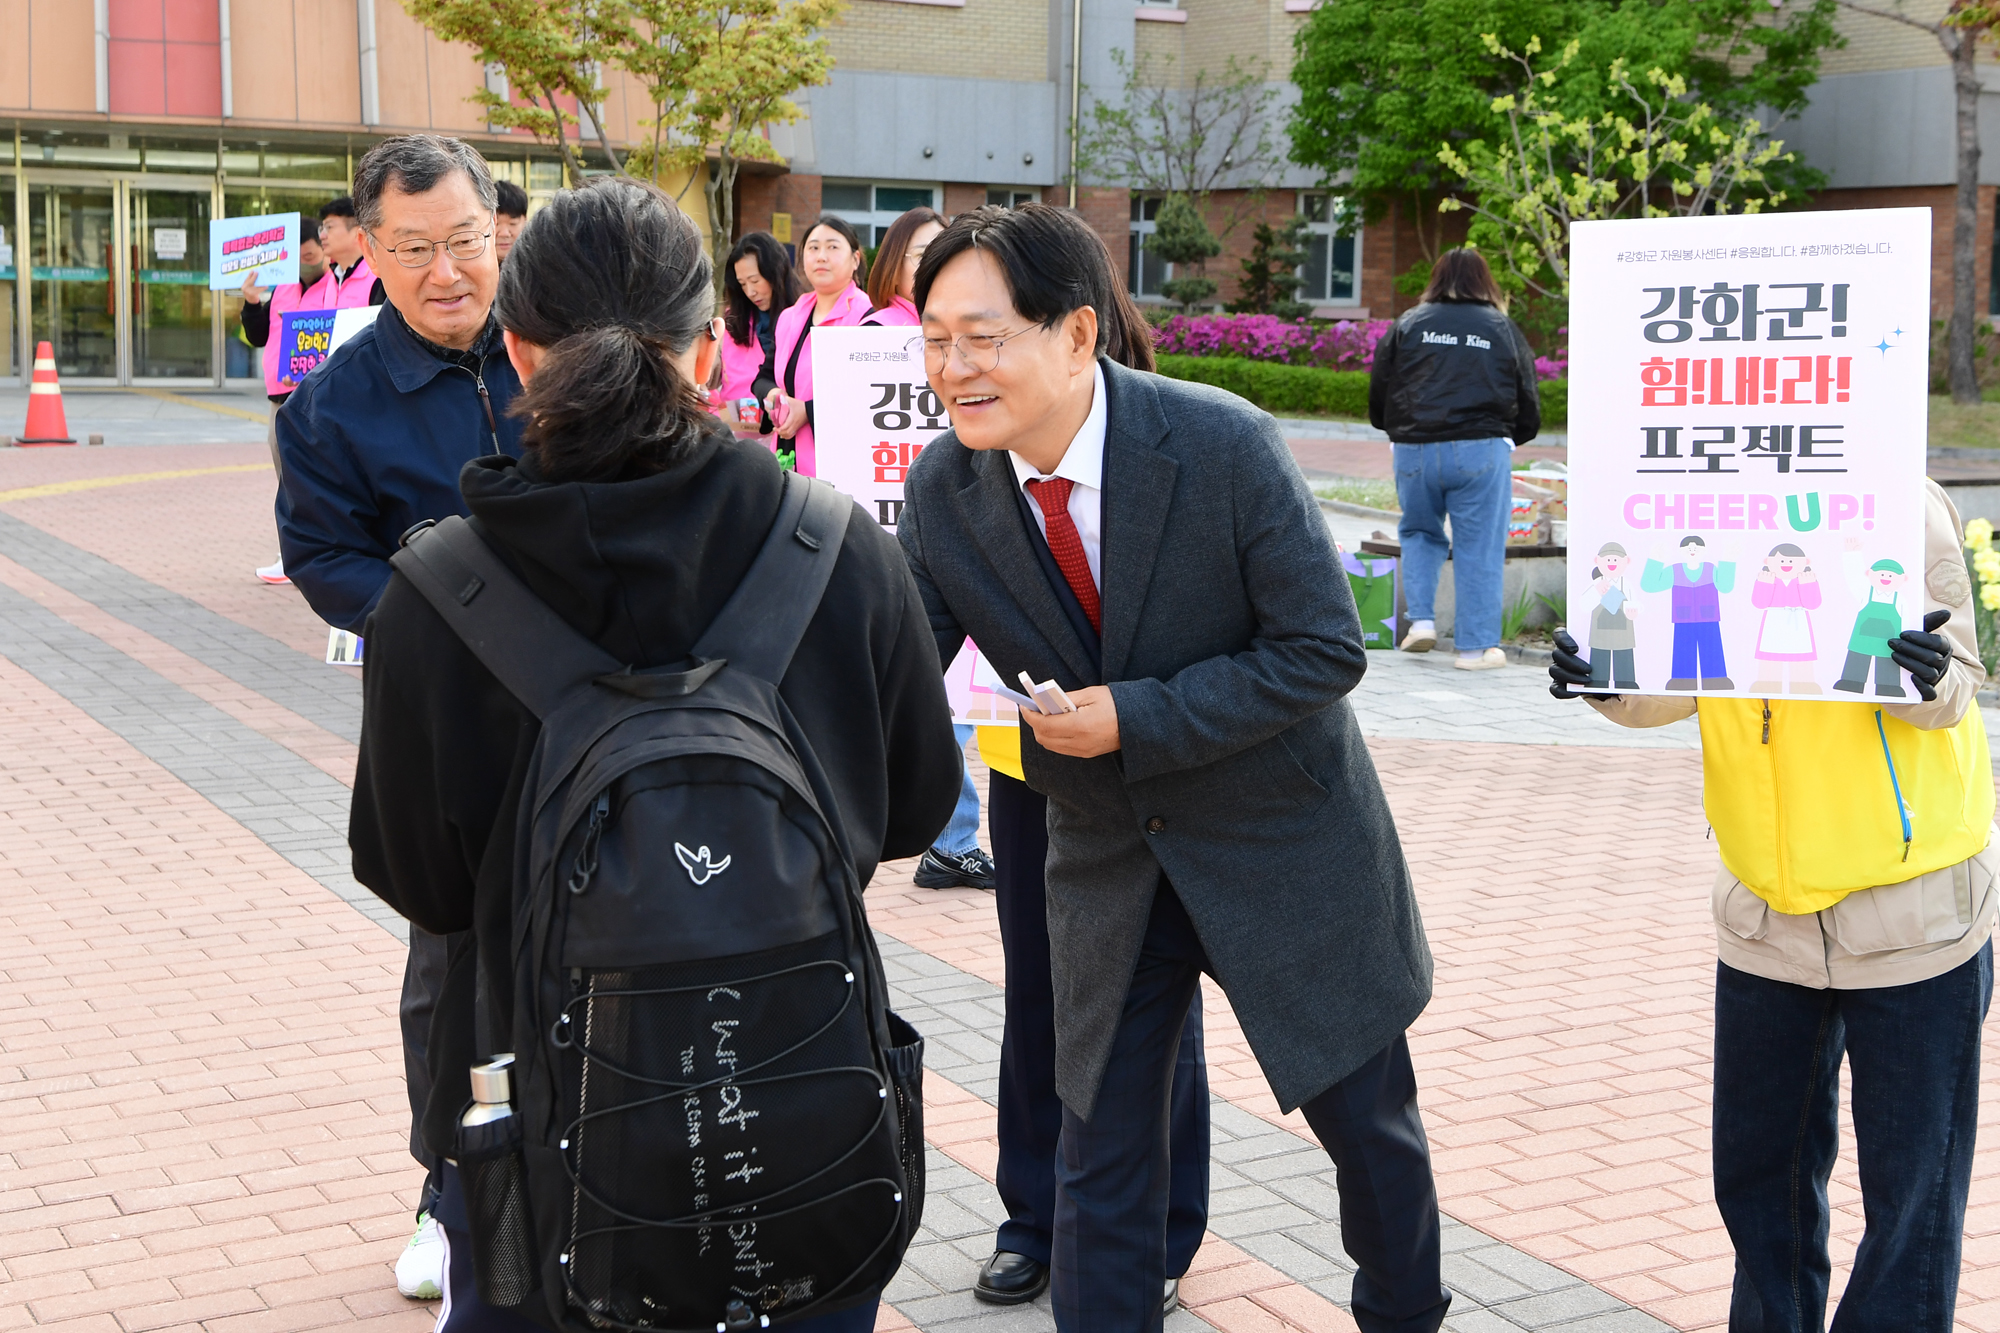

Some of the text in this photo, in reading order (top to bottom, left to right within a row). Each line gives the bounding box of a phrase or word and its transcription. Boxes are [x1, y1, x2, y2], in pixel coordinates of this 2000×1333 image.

[1617, 241, 1893, 264] #강화군 자원봉사센터 #응원합니다. #함께하겠습니다.
[1640, 282, 1851, 344] 강화군!
[296, 331, 330, 353] 우리학교
[1422, 330, 1491, 350] Matin Kim
[849, 351, 911, 362] #강화군 자원봉
[1640, 355, 1853, 407] 힘!내!라!
[1636, 425, 1848, 473] 프로젝트
[1623, 491, 1875, 532] CHEER UP!
[680, 1045, 695, 1076] THE
